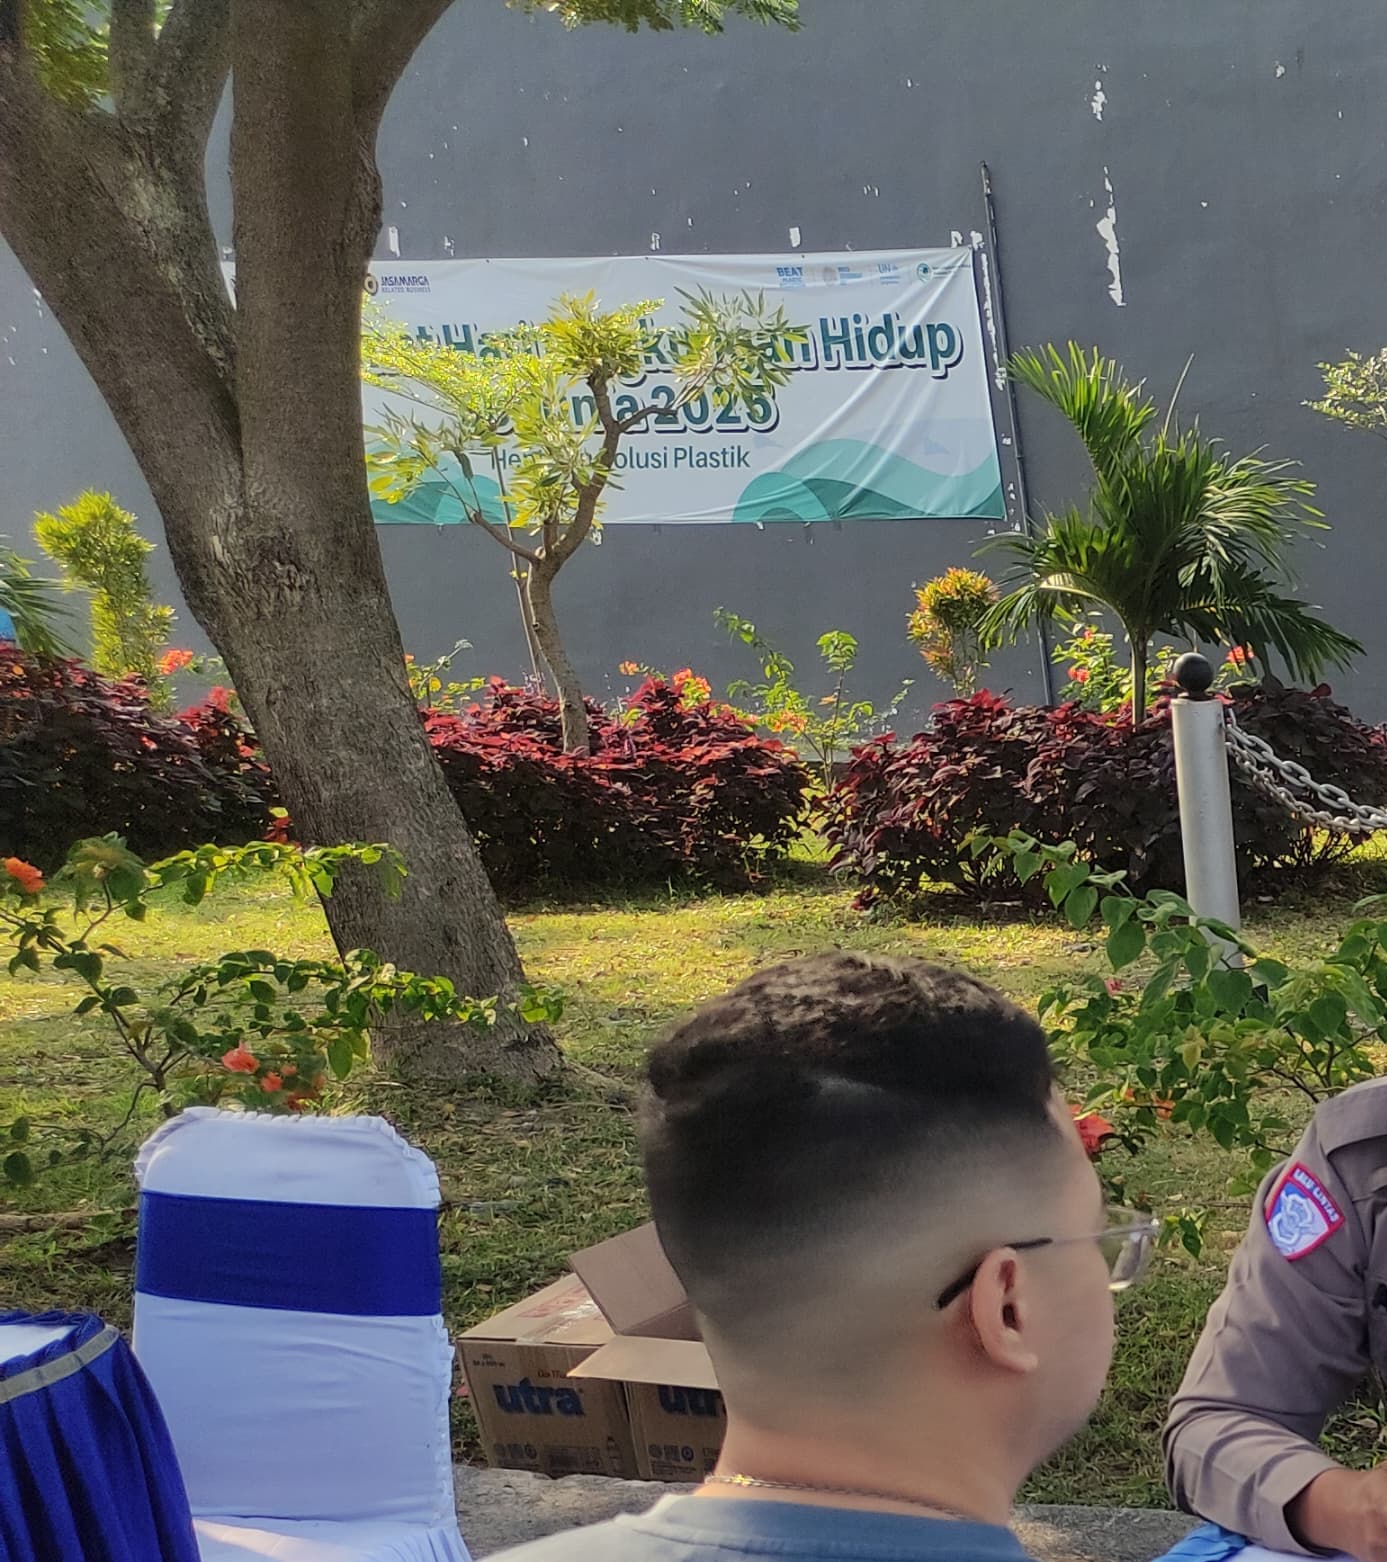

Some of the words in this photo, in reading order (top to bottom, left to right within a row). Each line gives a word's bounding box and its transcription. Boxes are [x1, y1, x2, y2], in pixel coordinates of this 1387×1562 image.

[820, 313, 961, 372] Hidup
[614, 449, 668, 470] olusi
[674, 446, 751, 470] Plastik
[493, 1378, 584, 1415] utra
